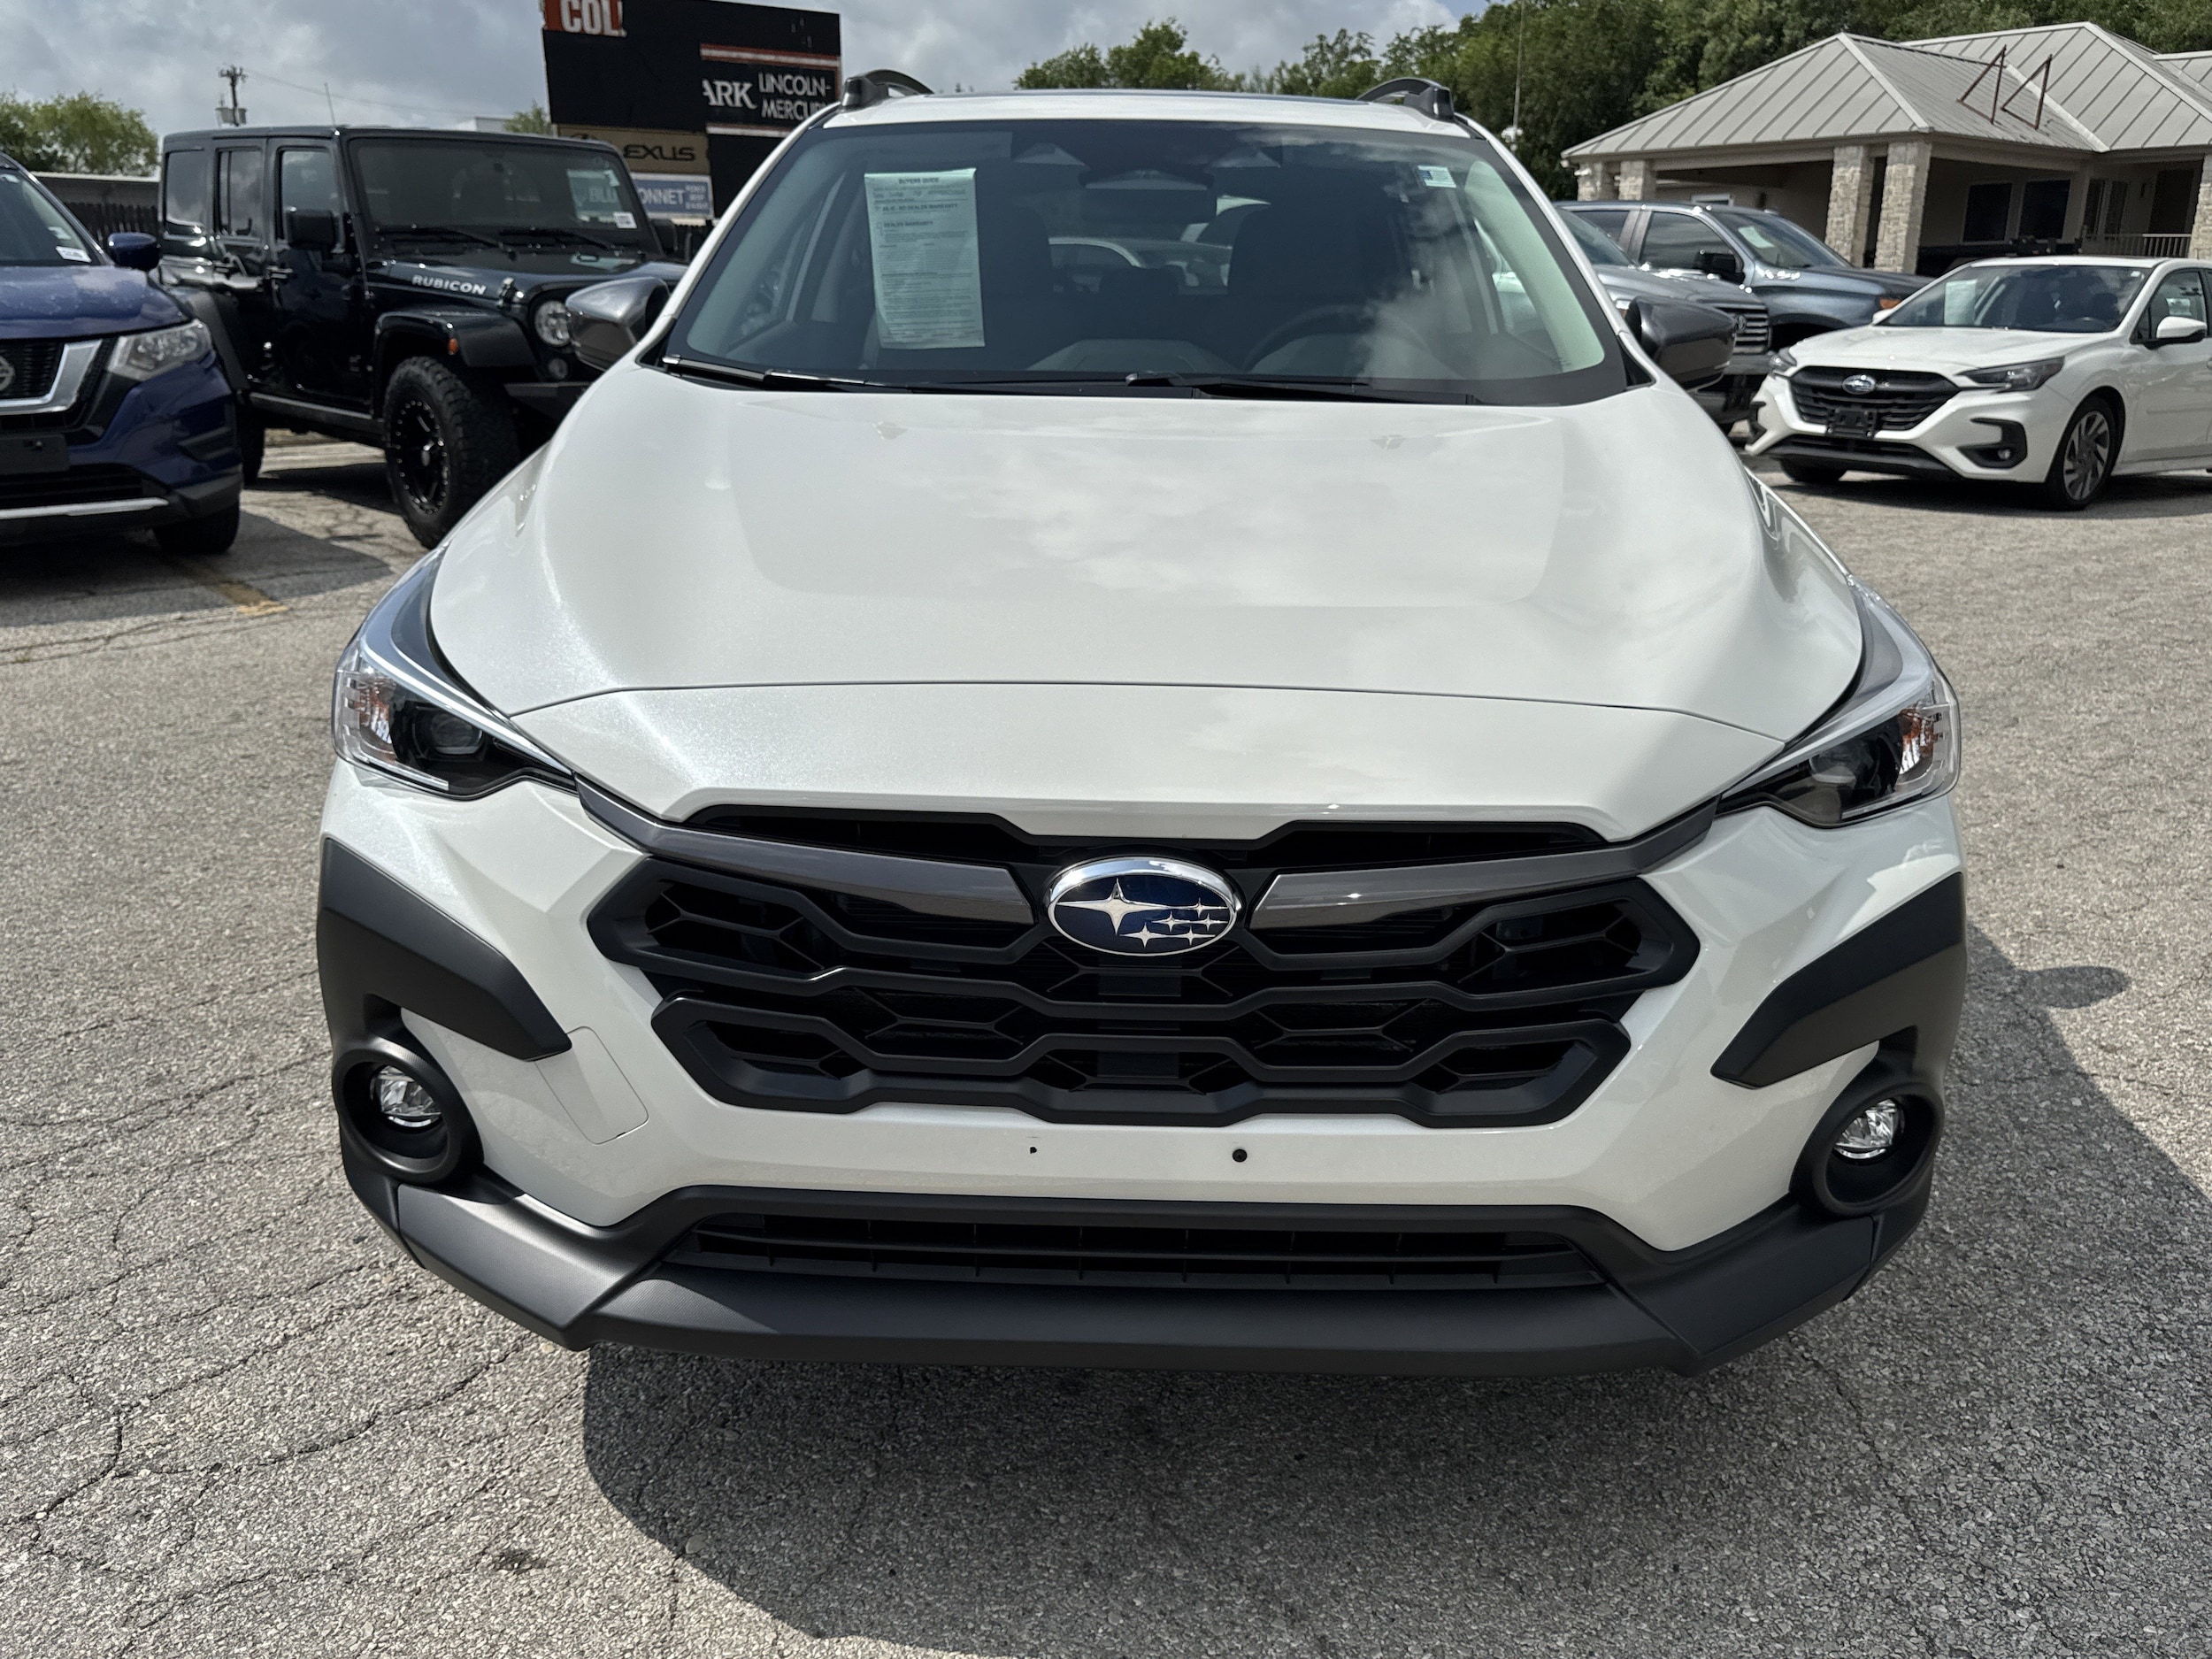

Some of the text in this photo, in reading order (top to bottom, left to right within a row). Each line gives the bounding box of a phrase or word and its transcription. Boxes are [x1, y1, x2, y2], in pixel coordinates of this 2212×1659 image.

[560, 0, 626, 37] COL
[623, 143, 696, 162] EXUS
[411, 274, 487, 296] RUBICON
